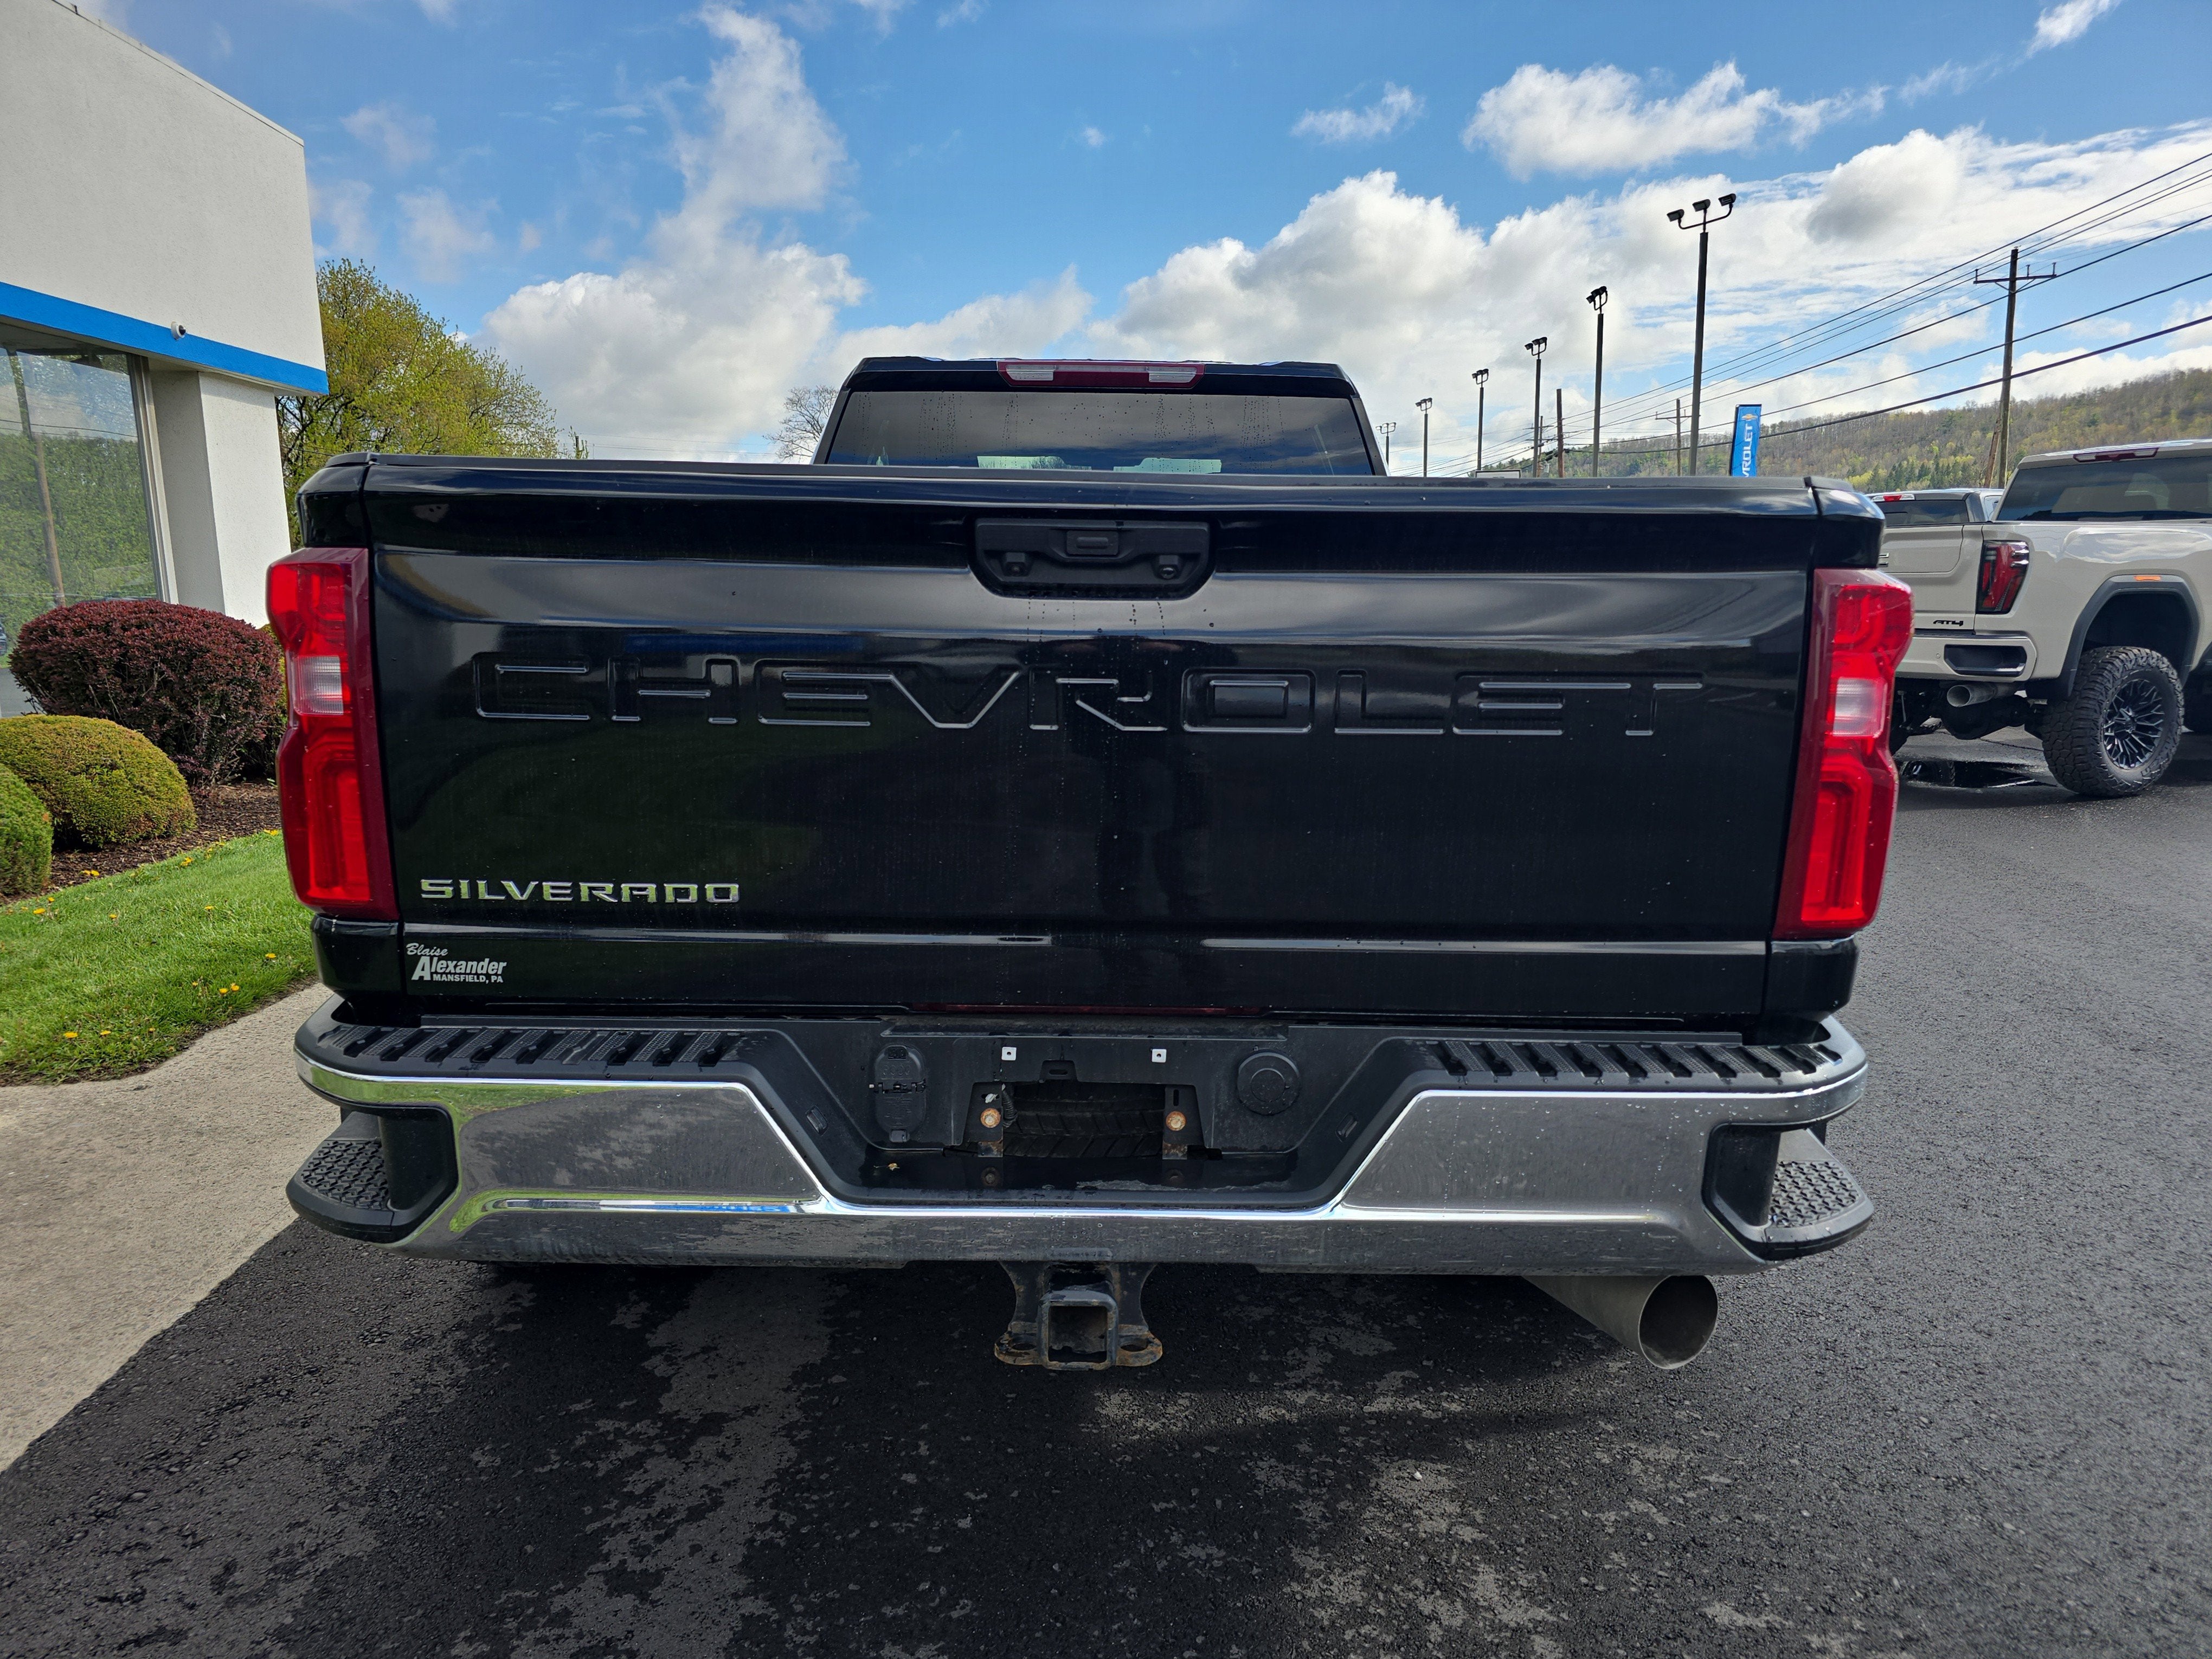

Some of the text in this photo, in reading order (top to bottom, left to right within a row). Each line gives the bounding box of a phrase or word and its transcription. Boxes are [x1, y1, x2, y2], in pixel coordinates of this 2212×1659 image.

[473, 654, 1704, 736] CHEVROLET
[420, 879, 741, 903] SILVERADO
[406, 942, 448, 956] Blaise
[411, 956, 507, 980] Alexander
[433, 974, 488, 985] MANSFIELD,
